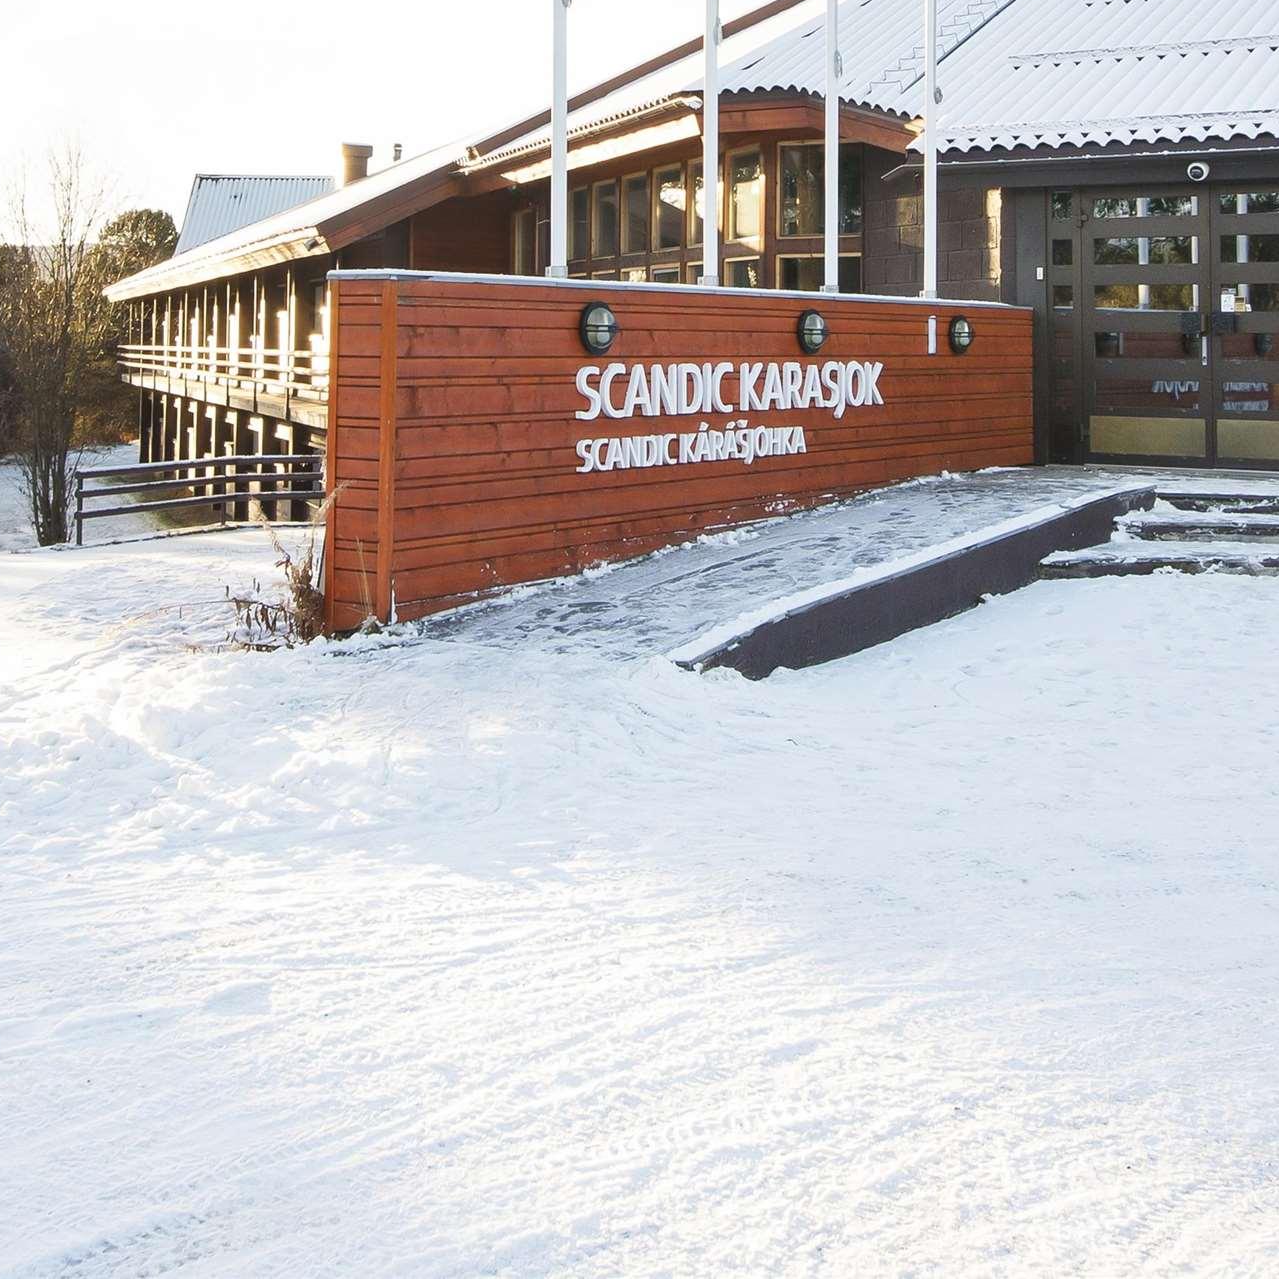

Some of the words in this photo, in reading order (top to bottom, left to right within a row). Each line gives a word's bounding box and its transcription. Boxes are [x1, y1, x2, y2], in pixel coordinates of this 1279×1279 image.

[575, 362, 734, 420] SCANDIC
[738, 360, 885, 419] KARASJOK
[575, 434, 679, 473] SCANDIC
[681, 419, 808, 465] KÁRÁŠJOHKA
